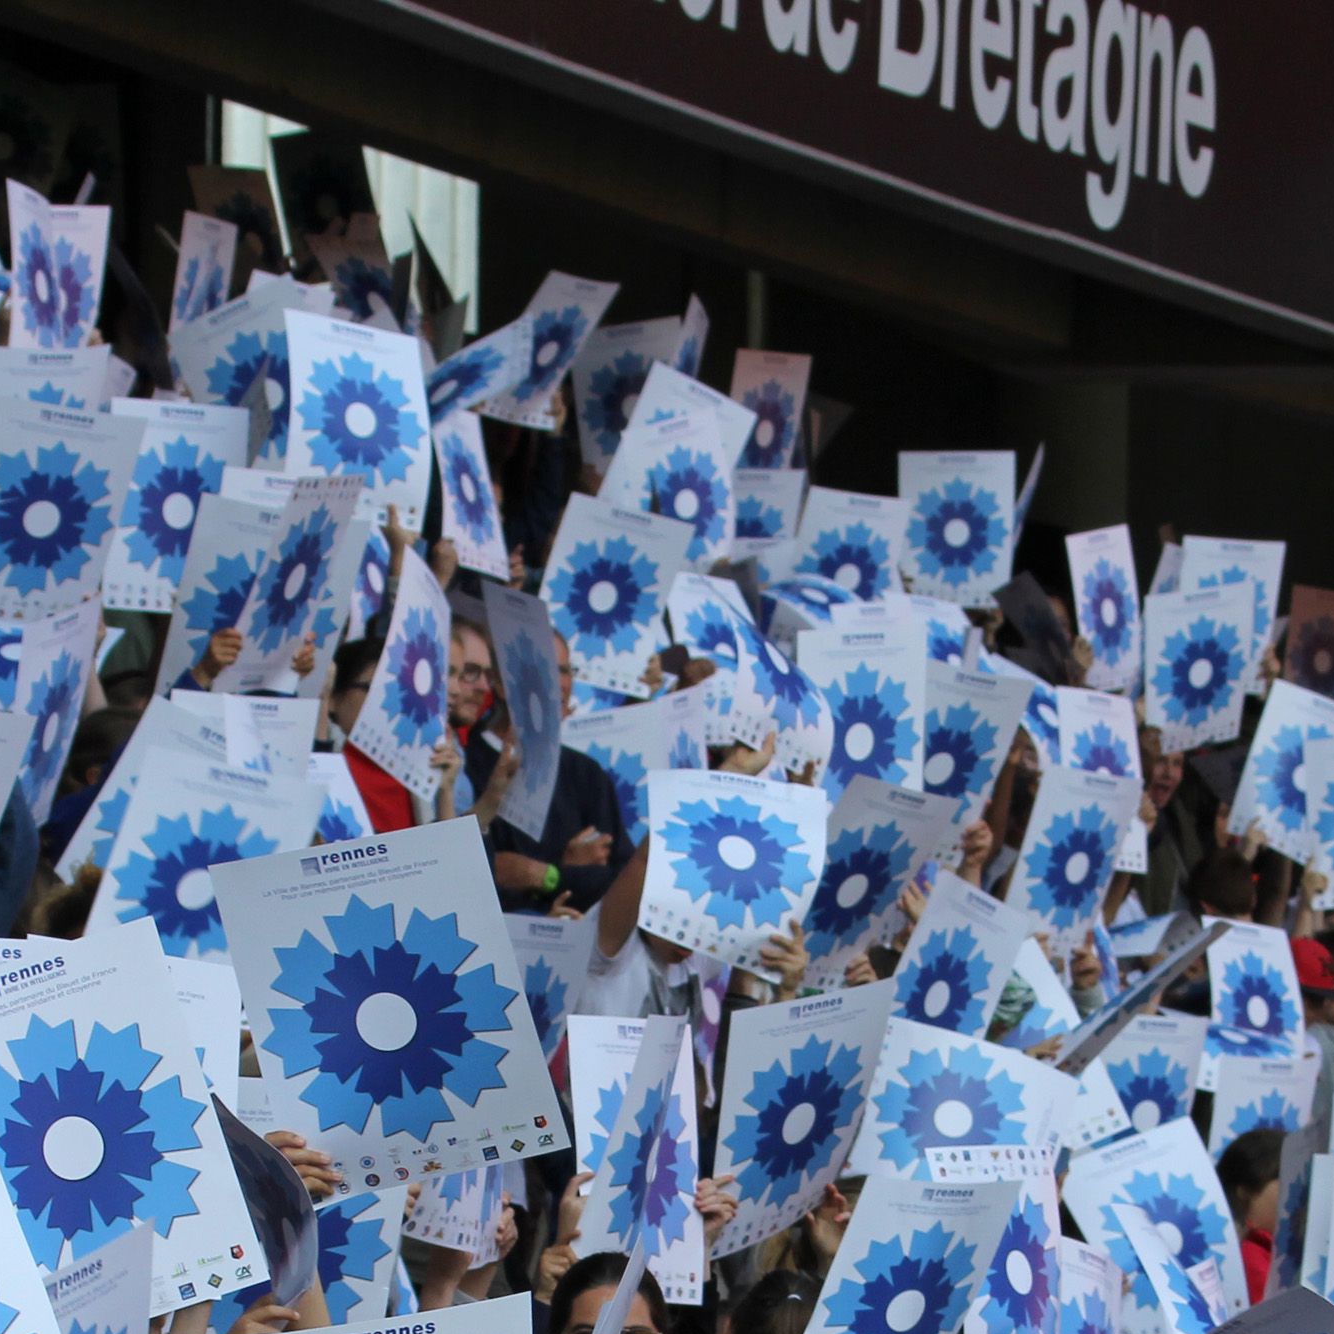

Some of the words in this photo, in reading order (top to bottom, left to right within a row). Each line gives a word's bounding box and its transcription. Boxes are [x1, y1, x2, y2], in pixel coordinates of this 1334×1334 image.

[54, 411, 95, 425] rennes
[321, 844, 387, 865] rennes
[1, 957, 64, 986] rennes
[801, 1001, 843, 1018] rennes
[935, 1188, 974, 1200] rennes
[60, 1258, 102, 1289] rennes
